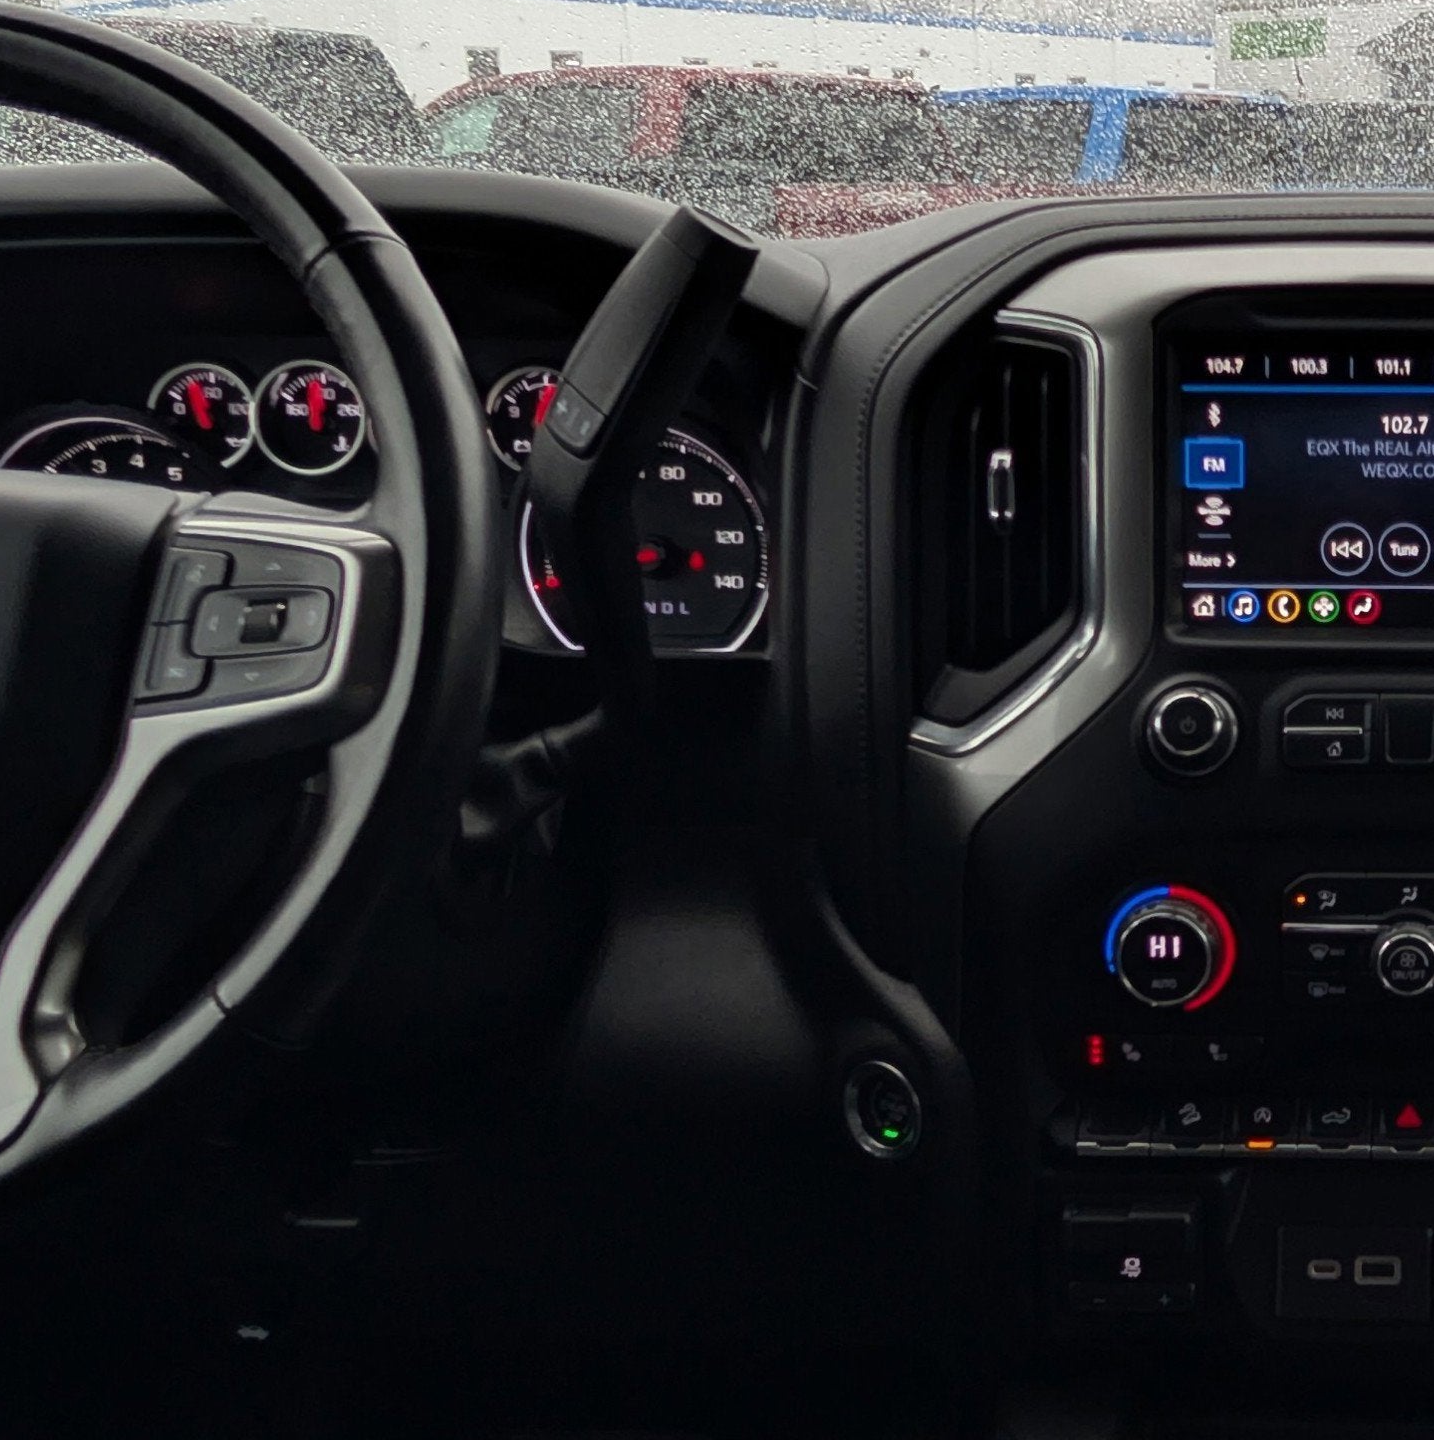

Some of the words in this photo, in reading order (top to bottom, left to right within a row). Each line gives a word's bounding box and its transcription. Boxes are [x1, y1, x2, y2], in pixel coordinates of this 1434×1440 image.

[1206, 357, 1244, 375] 104.7
[1291, 358, 1328, 375] 100.3
[1376, 358, 1411, 376] 101.1
[172, 401, 187, 416] 0
[1381, 415, 1429, 435] 102.7
[1306, 439, 1340, 457] EQX
[1342, 440, 1370, 456] The
[1374, 440, 1413, 457] REAL
[91, 459, 108, 474] 3
[129, 453, 145, 468] 4
[1202, 457, 1226, 473] FM
[167, 466, 183, 482] 5
[658, 465, 686, 481] 80
[691, 491, 723, 507] 100
[715, 530, 745, 545] 120
[1388, 541, 1420, 557] Tune
[1188, 551, 1222, 568] More
[713, 575, 745, 590] 140
[1149, 935, 1181, 959] HI
